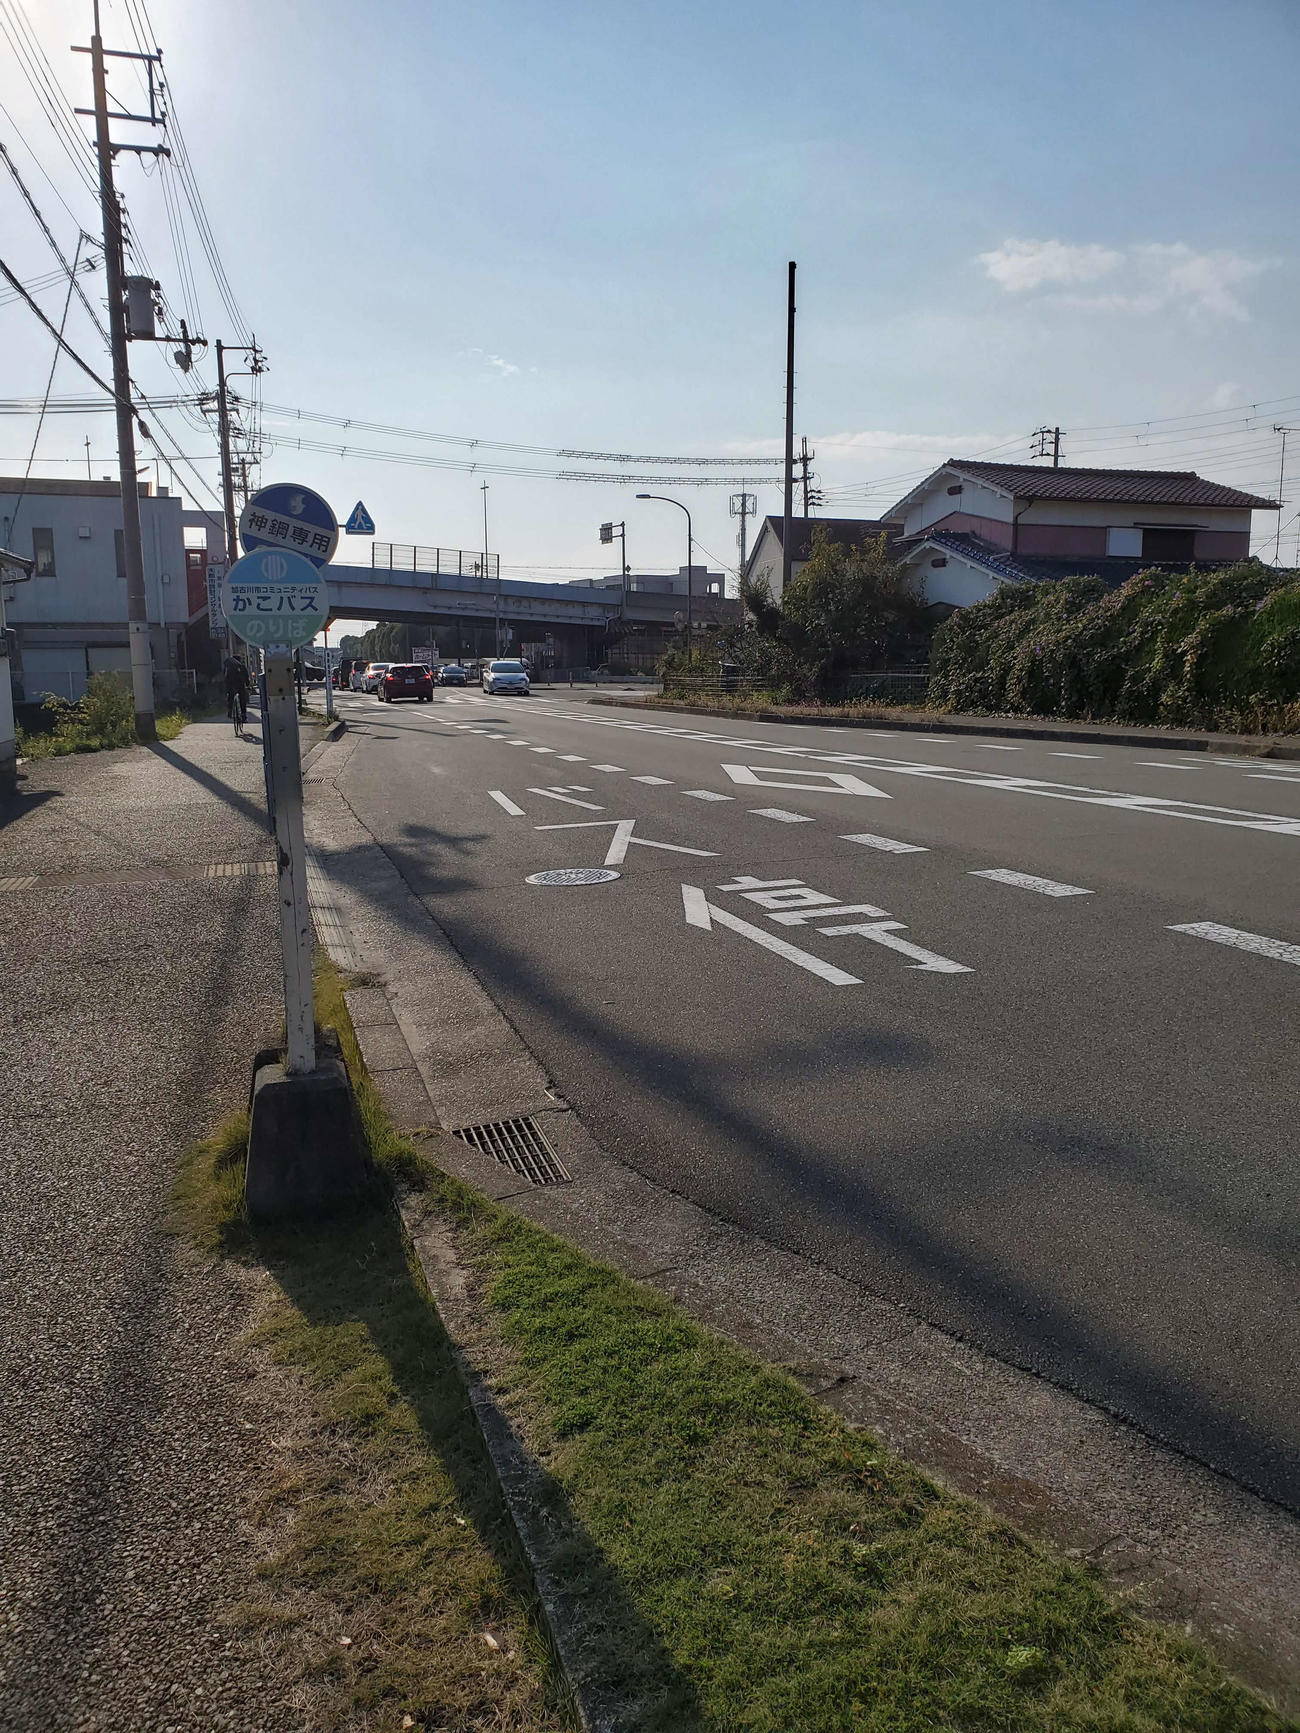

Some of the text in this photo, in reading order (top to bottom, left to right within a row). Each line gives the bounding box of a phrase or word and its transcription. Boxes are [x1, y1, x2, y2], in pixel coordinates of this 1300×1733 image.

[248, 512, 331, 553] 神鋼専用
[231, 586, 319, 594] 加古川市コミュニティバス
[233, 595, 319, 612] かこバス
[246, 618, 308, 638] のりば
